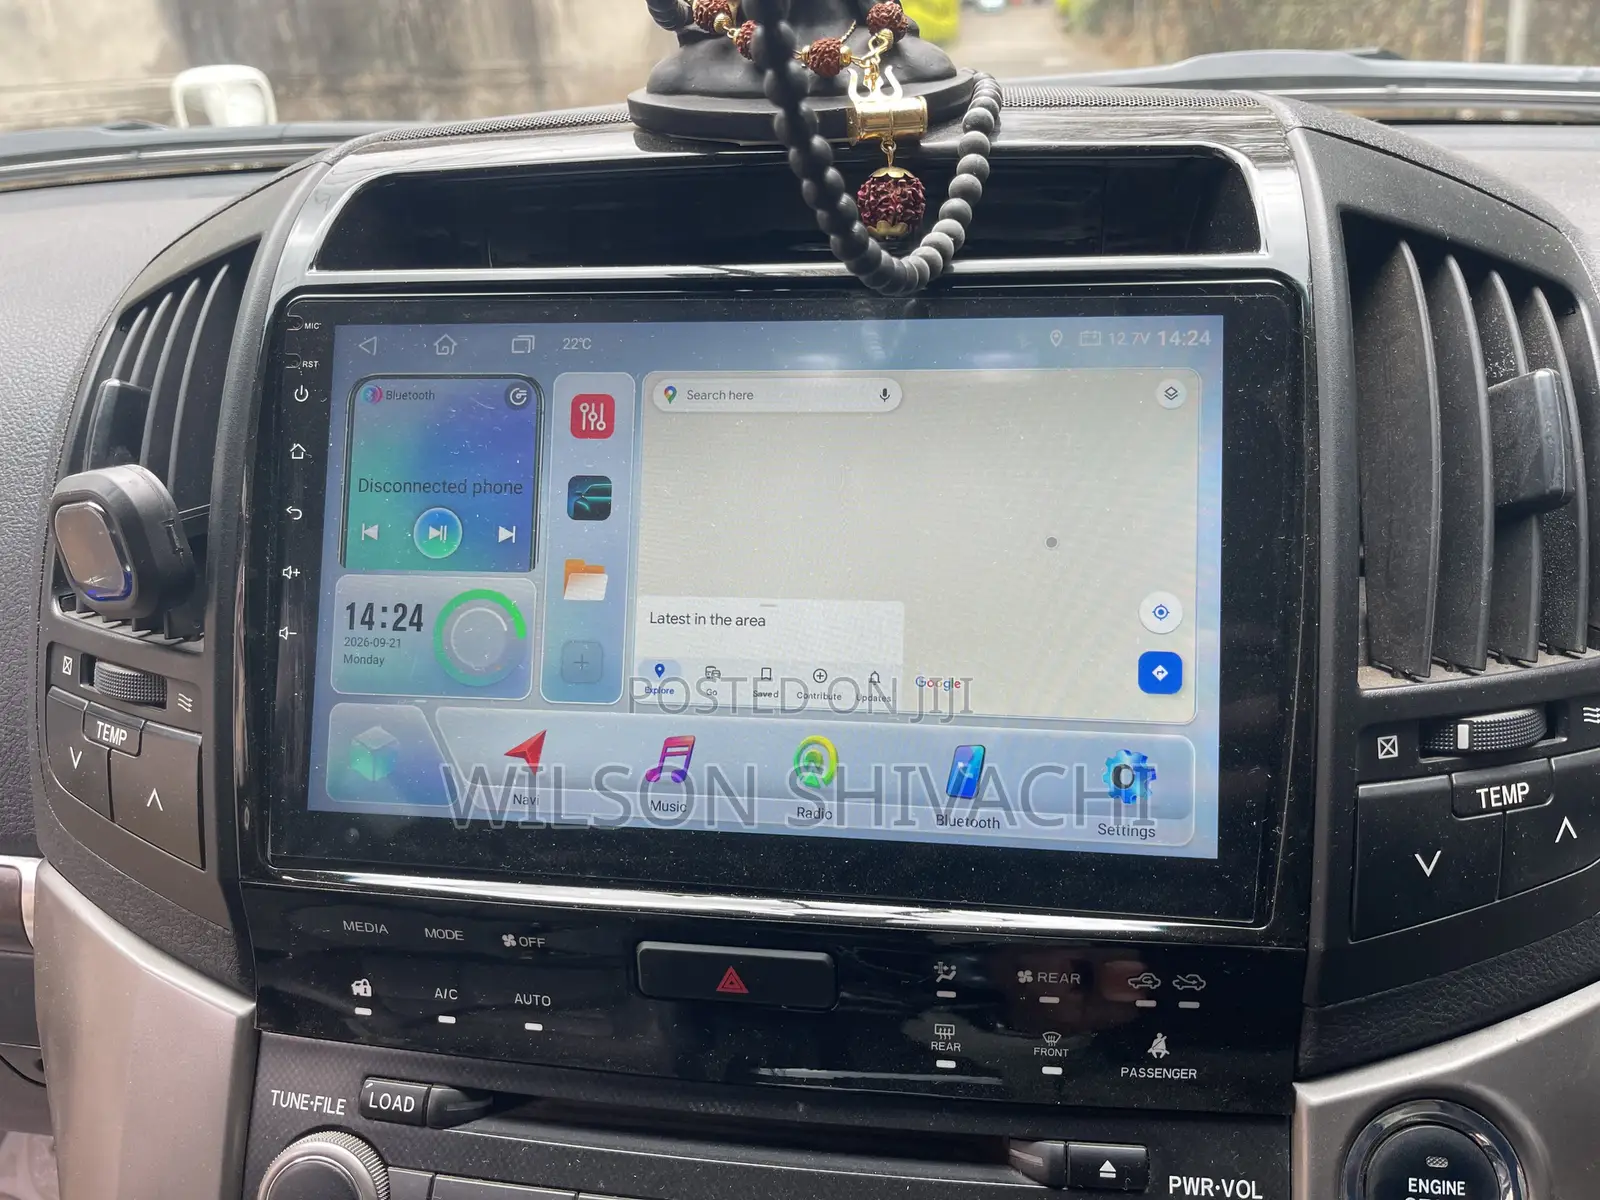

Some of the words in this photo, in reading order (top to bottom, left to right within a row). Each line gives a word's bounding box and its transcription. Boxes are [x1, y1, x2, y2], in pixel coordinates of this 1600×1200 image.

[304, 322, 319, 330] MIC
[1108, 332, 1151, 346] 127V
[1157, 329, 1212, 346] 14:24
[302, 360, 319, 368] RST
[385, 389, 436, 401] Bluetooth
[686, 389, 725, 402] Search
[728, 389, 754, 401] here
[358, 478, 467, 494] Disconnected
[472, 479, 524, 497] phone
[345, 601, 424, 633] 14:24
[650, 612, 691, 625] Latest
[694, 613, 707, 626] in
[710, 613, 732, 626] the
[735, 616, 766, 627] area
[344, 636, 402, 649] 2026-09-21
[343, 653, 386, 668] Monday
[915, 675, 961, 691] Google
[644, 686, 675, 696] Explore
[706, 689, 718, 697] Go
[752, 690, 779, 699] Saved
[796, 691, 842, 701] Contribute
[855, 693, 892, 703] Updates
[97, 720, 128, 746] TEMP
[513, 793, 541, 806] Navi
[1476, 781, 1530, 809] TEMP
[650, 799, 688, 813] Music
[796, 807, 833, 821] Radio
[935, 814, 1001, 830] Bluetooth
[1097, 824, 1156, 841] Settings
[343, 920, 389, 935] MEDIA
[424, 928, 465, 941] MODE
[518, 936, 546, 948] OFF
[1037, 972, 1082, 985] REAR
[434, 988, 458, 1001] A/C
[514, 993, 551, 1007] AUTO
[931, 1041, 962, 1052] REAR
[1033, 1047, 1070, 1058] FRONT
[1120, 1067, 1198, 1080] PASSENGER
[368, 1091, 416, 1113] LOAD
[1408, 1177, 1466, 1196] ENGINE
